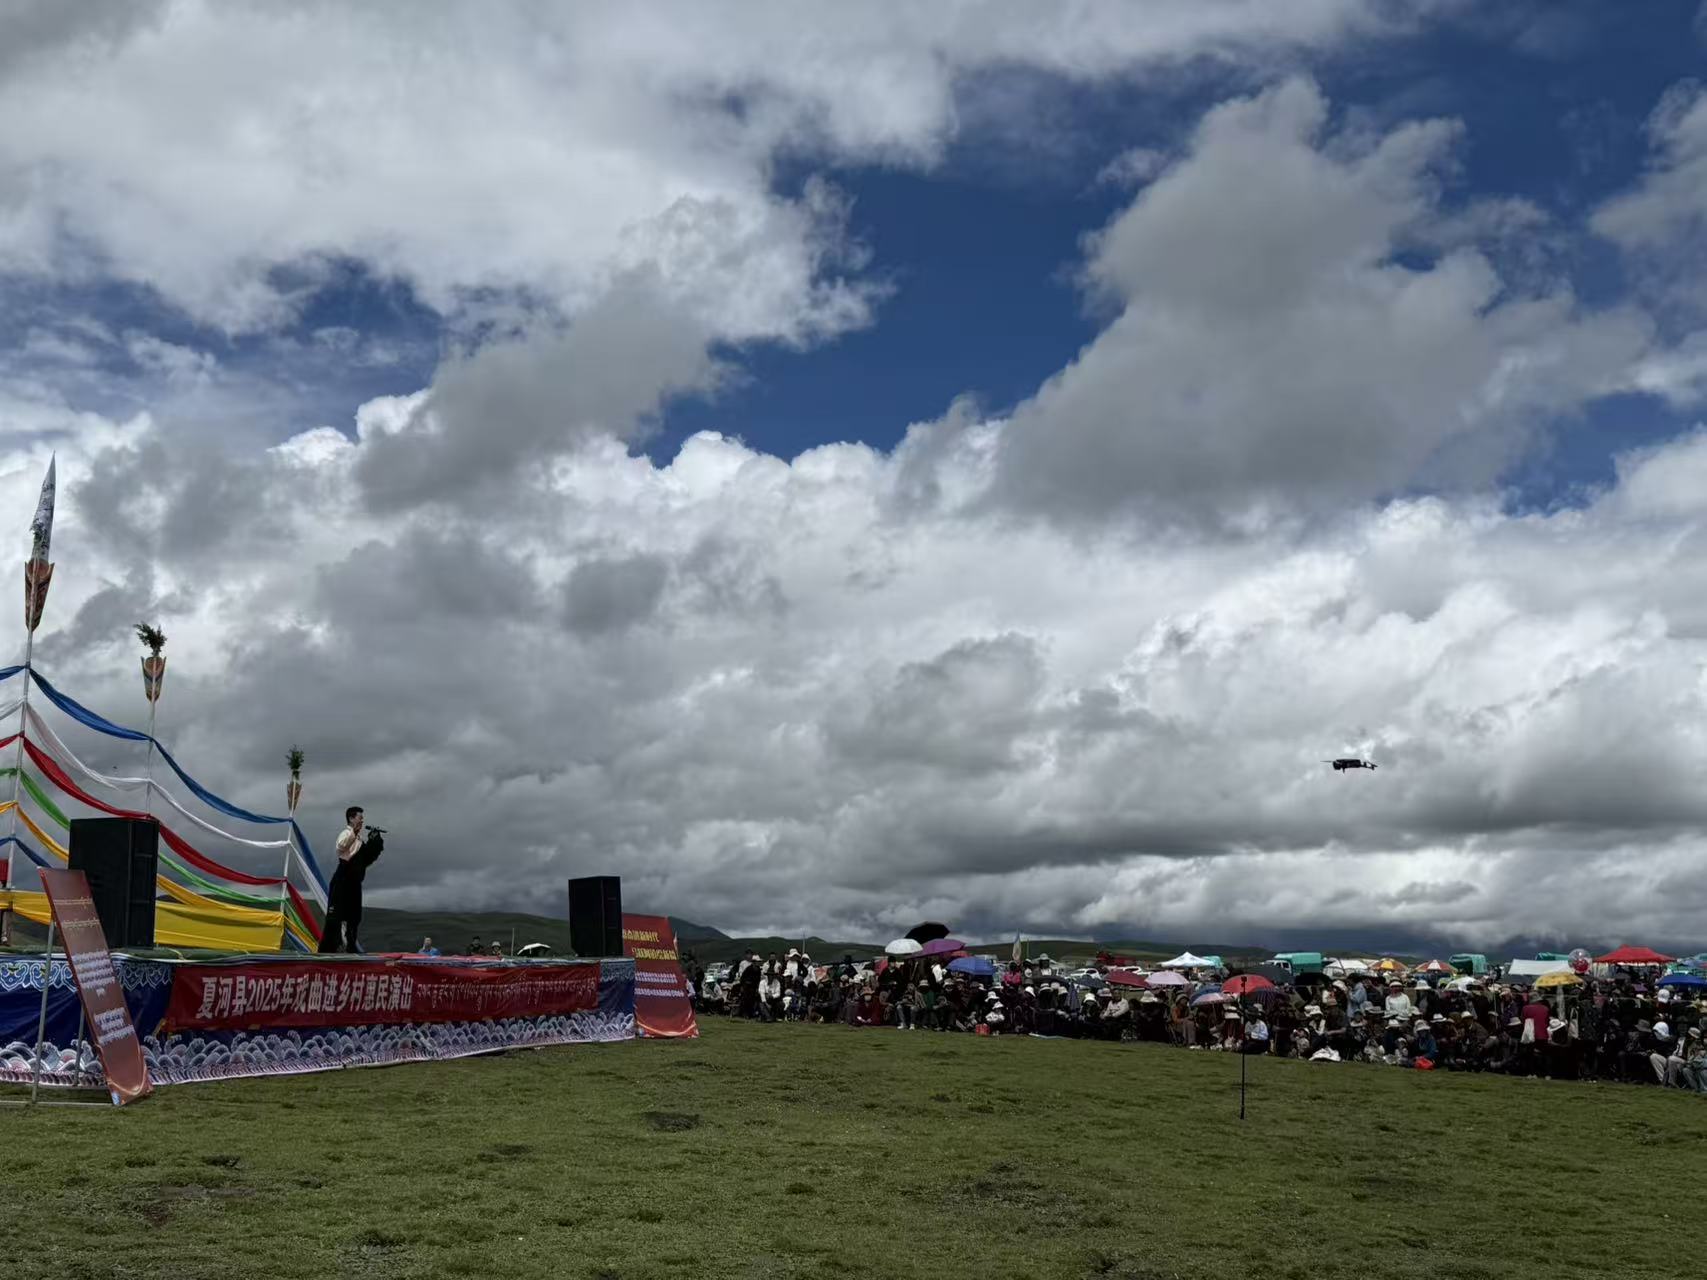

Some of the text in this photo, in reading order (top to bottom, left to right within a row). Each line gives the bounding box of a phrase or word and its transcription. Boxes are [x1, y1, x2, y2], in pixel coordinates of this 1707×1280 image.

[196, 974, 414, 1019] 夏河县2025年戏曲进乡村惠民演出
